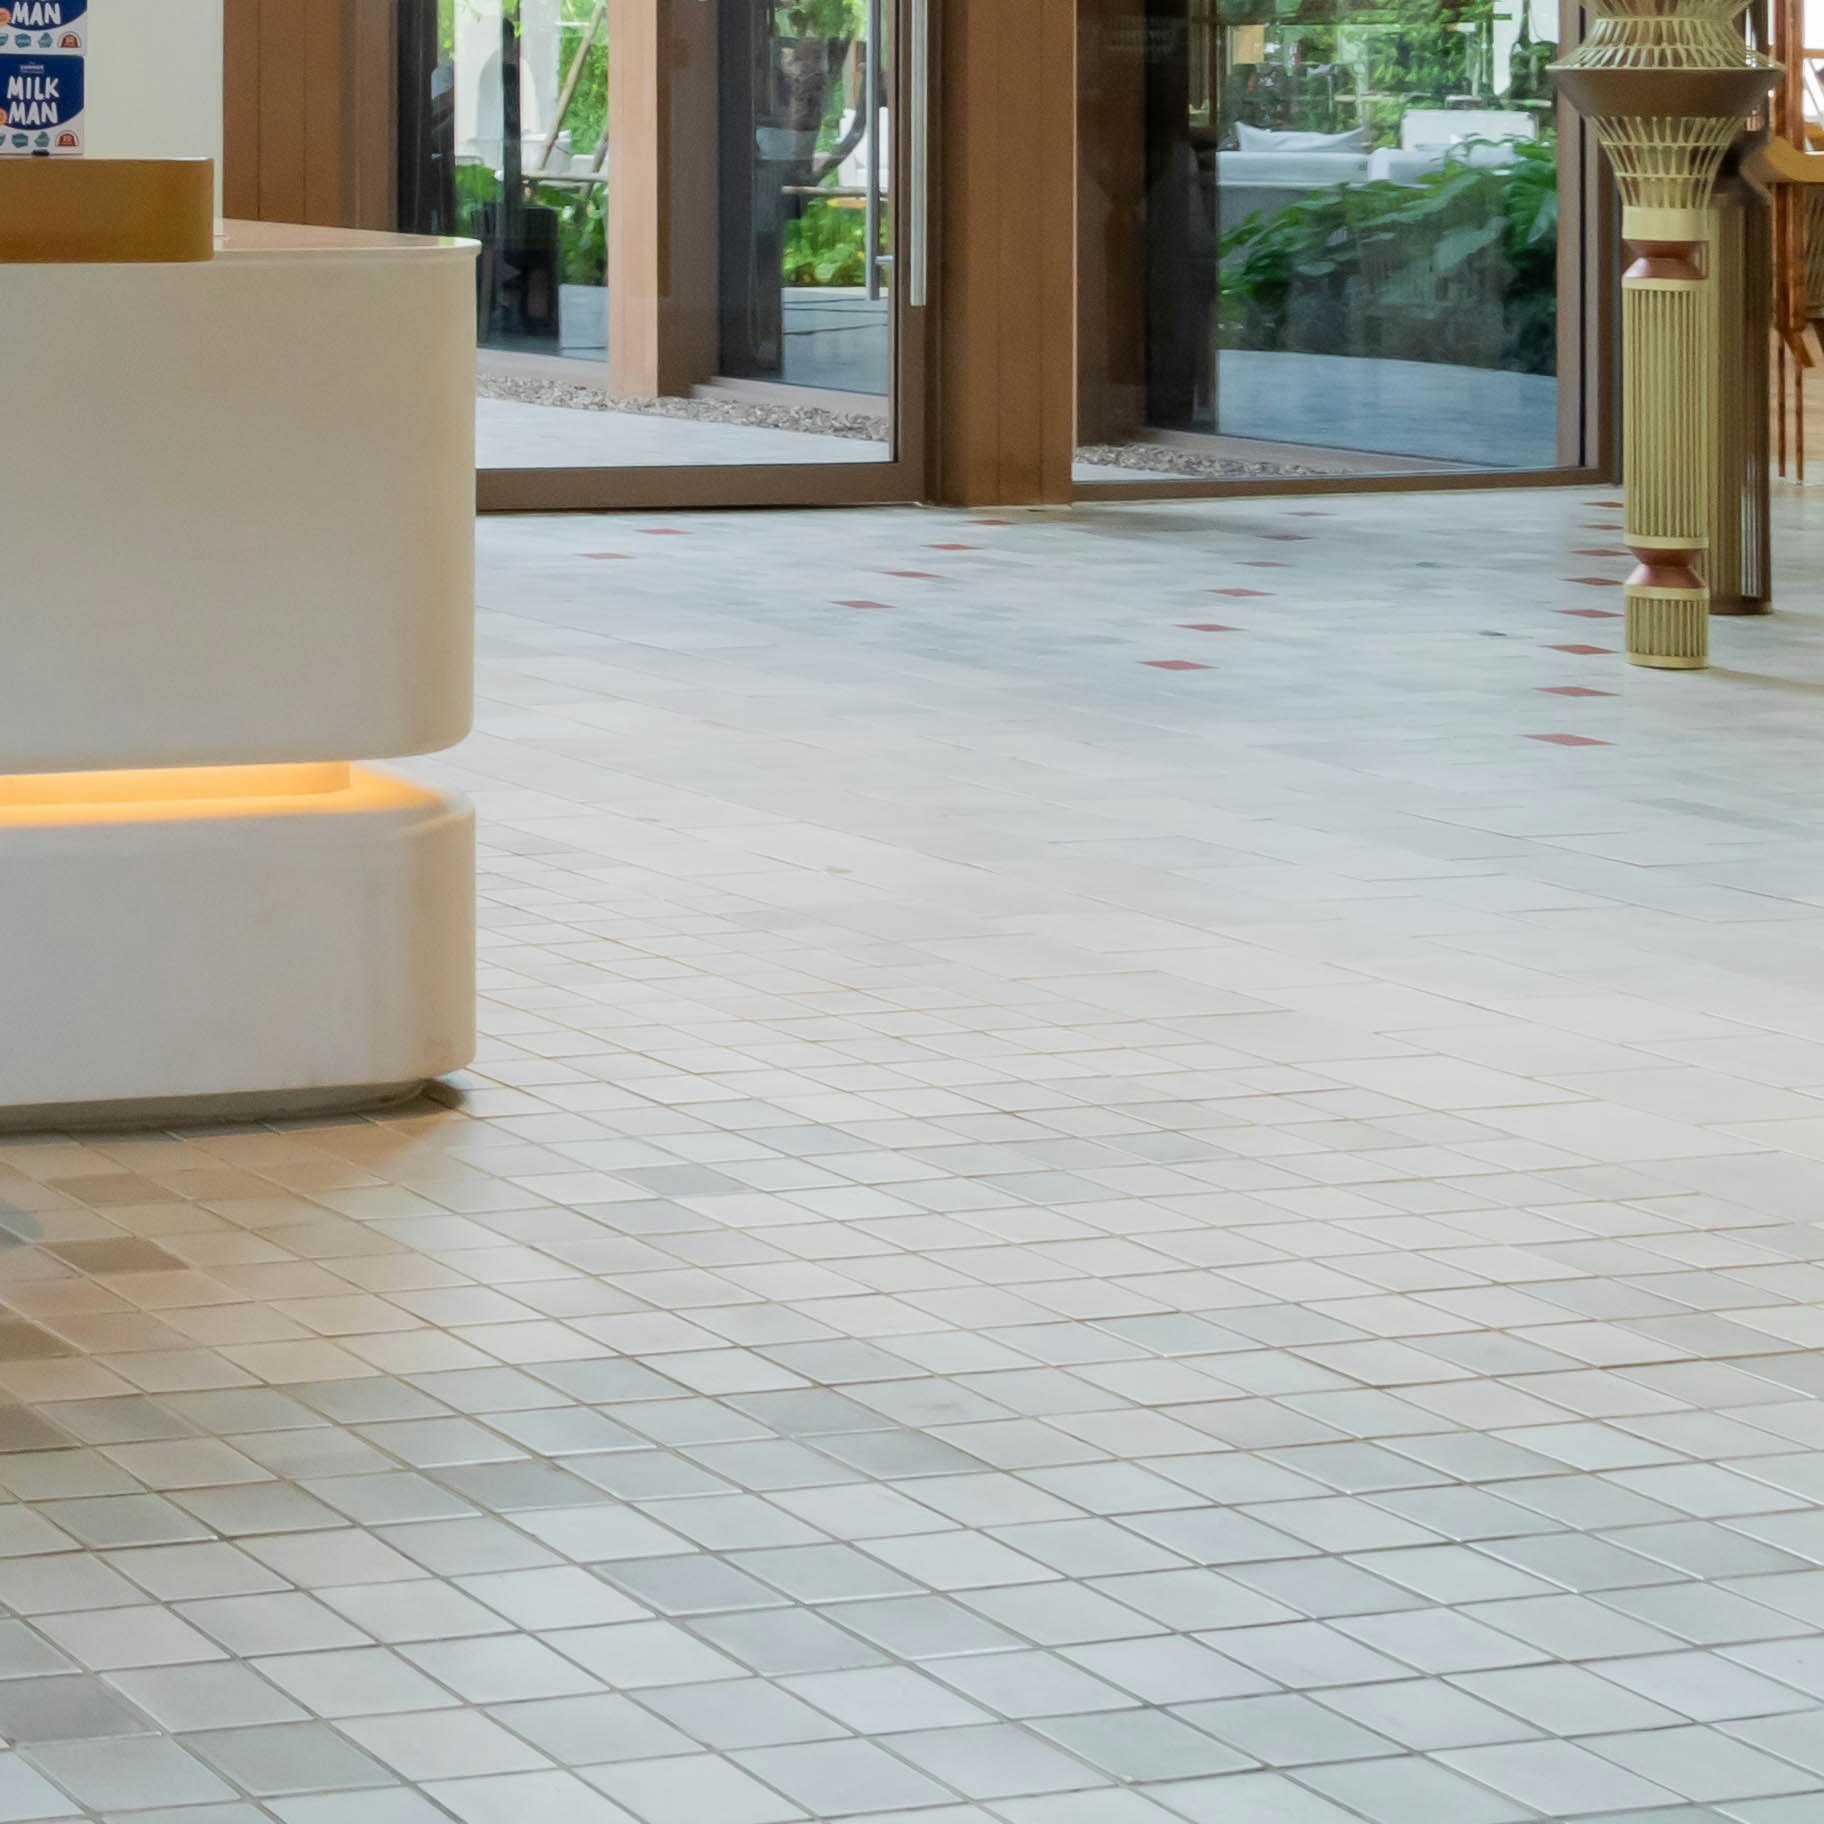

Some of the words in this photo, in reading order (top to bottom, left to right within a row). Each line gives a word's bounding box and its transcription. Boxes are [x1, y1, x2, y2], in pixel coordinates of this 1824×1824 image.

[11, 1, 62, 26] MAN
[6, 75, 60, 101] MILK
[8, 100, 59, 126] MAN
